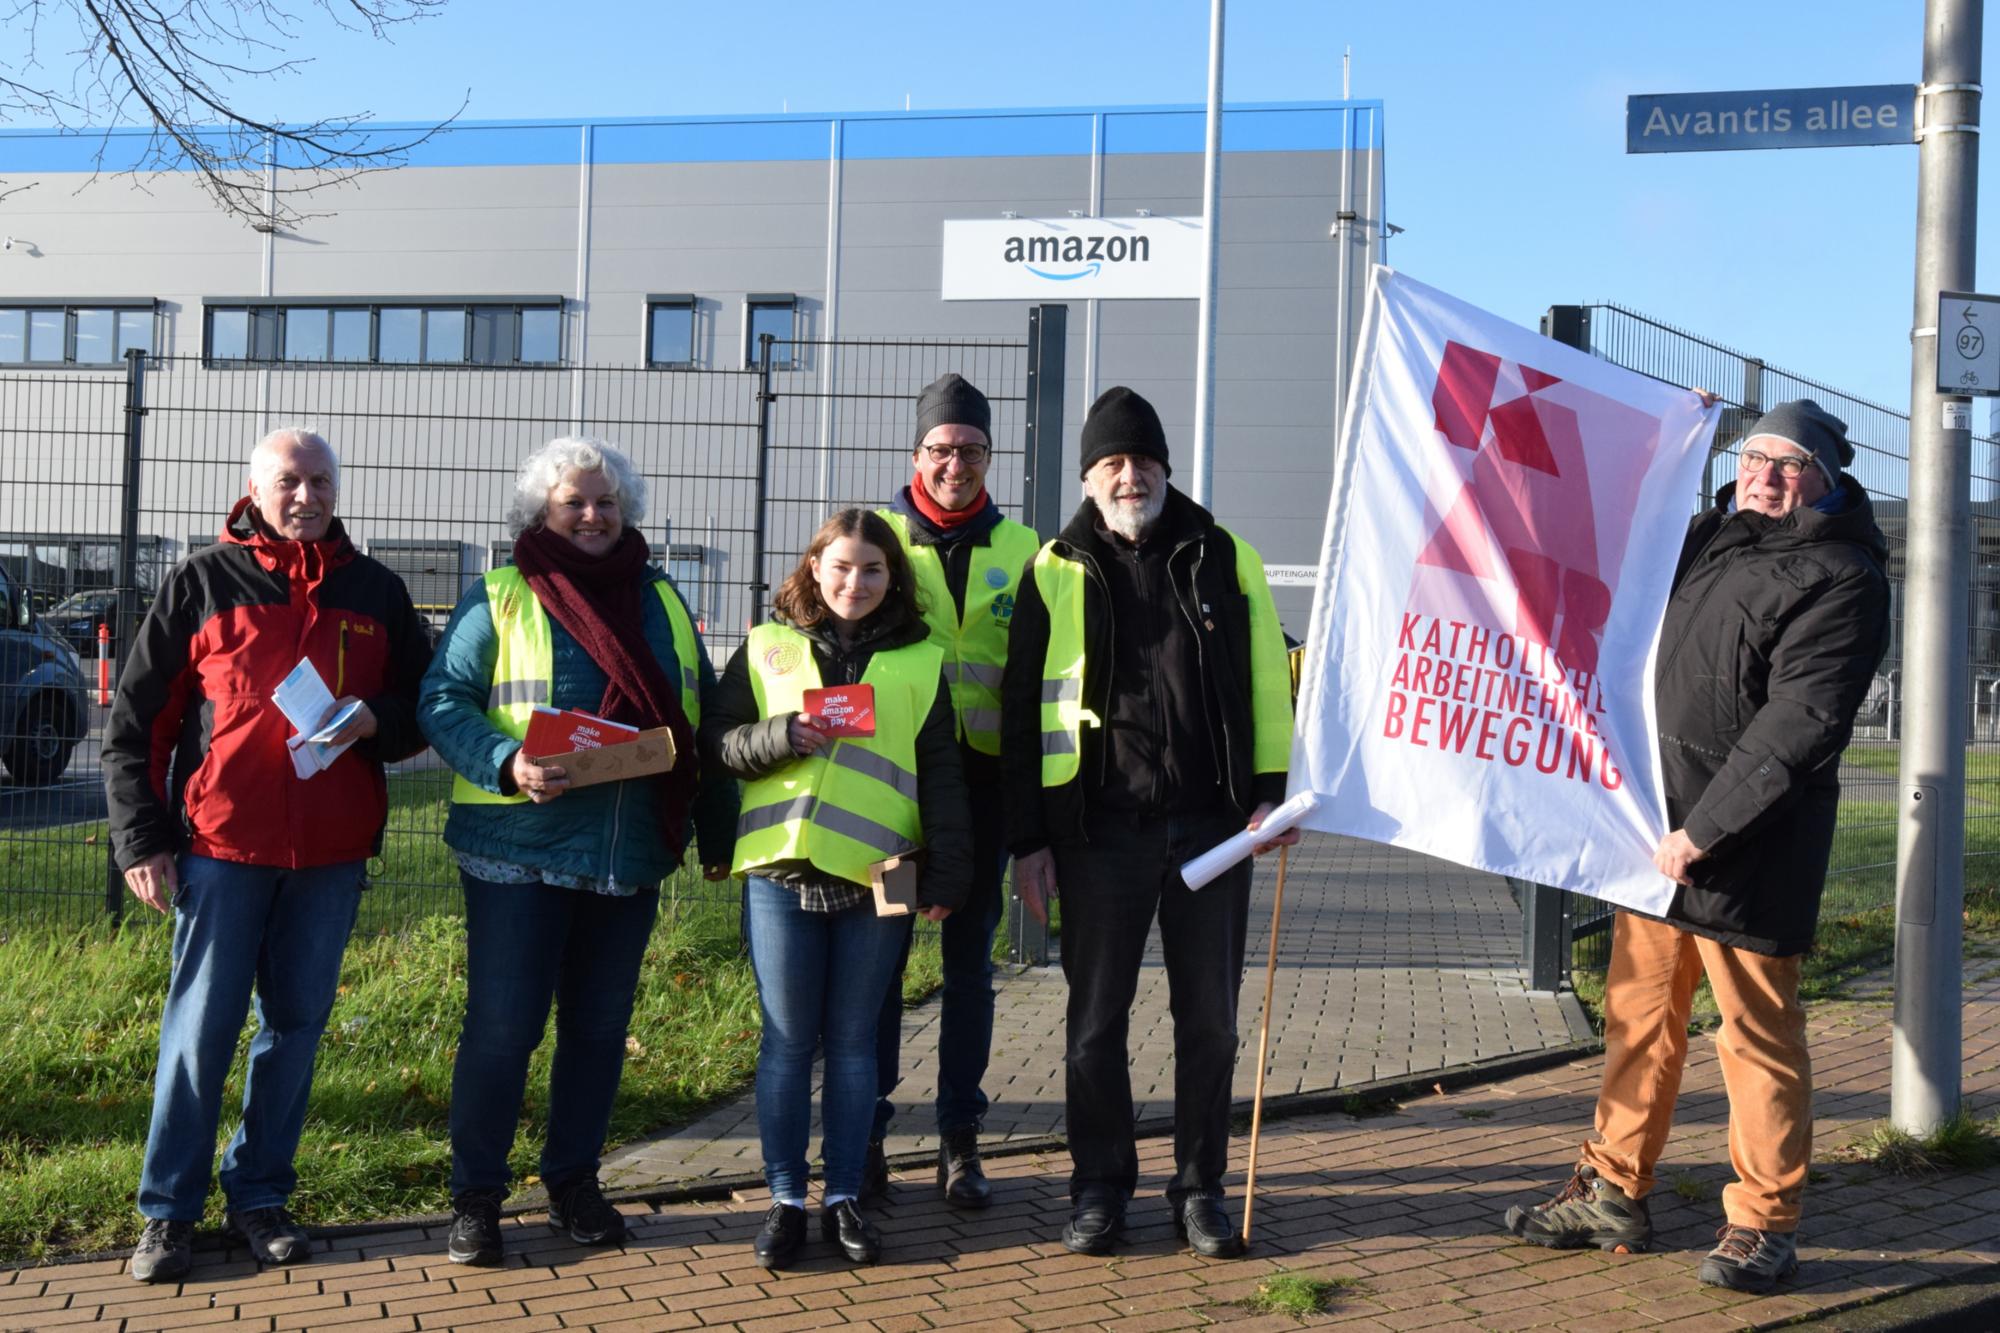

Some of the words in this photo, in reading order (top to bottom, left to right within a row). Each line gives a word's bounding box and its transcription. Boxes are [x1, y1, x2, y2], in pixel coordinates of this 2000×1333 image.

[1643, 102, 1791, 136] Avantis
[1805, 100, 1898, 131] allee
[1004, 235, 1149, 263] amazon
[1960, 334, 1980, 350] 97
[824, 694, 848, 704] make
[1391, 653, 1605, 741] ARBEITNEHME
[821, 705, 854, 716] amazon
[830, 717, 847, 727] pay
[577, 724, 600, 738] make
[569, 733, 602, 749] amazon
[1383, 690, 1623, 791] BEWEGUNG
